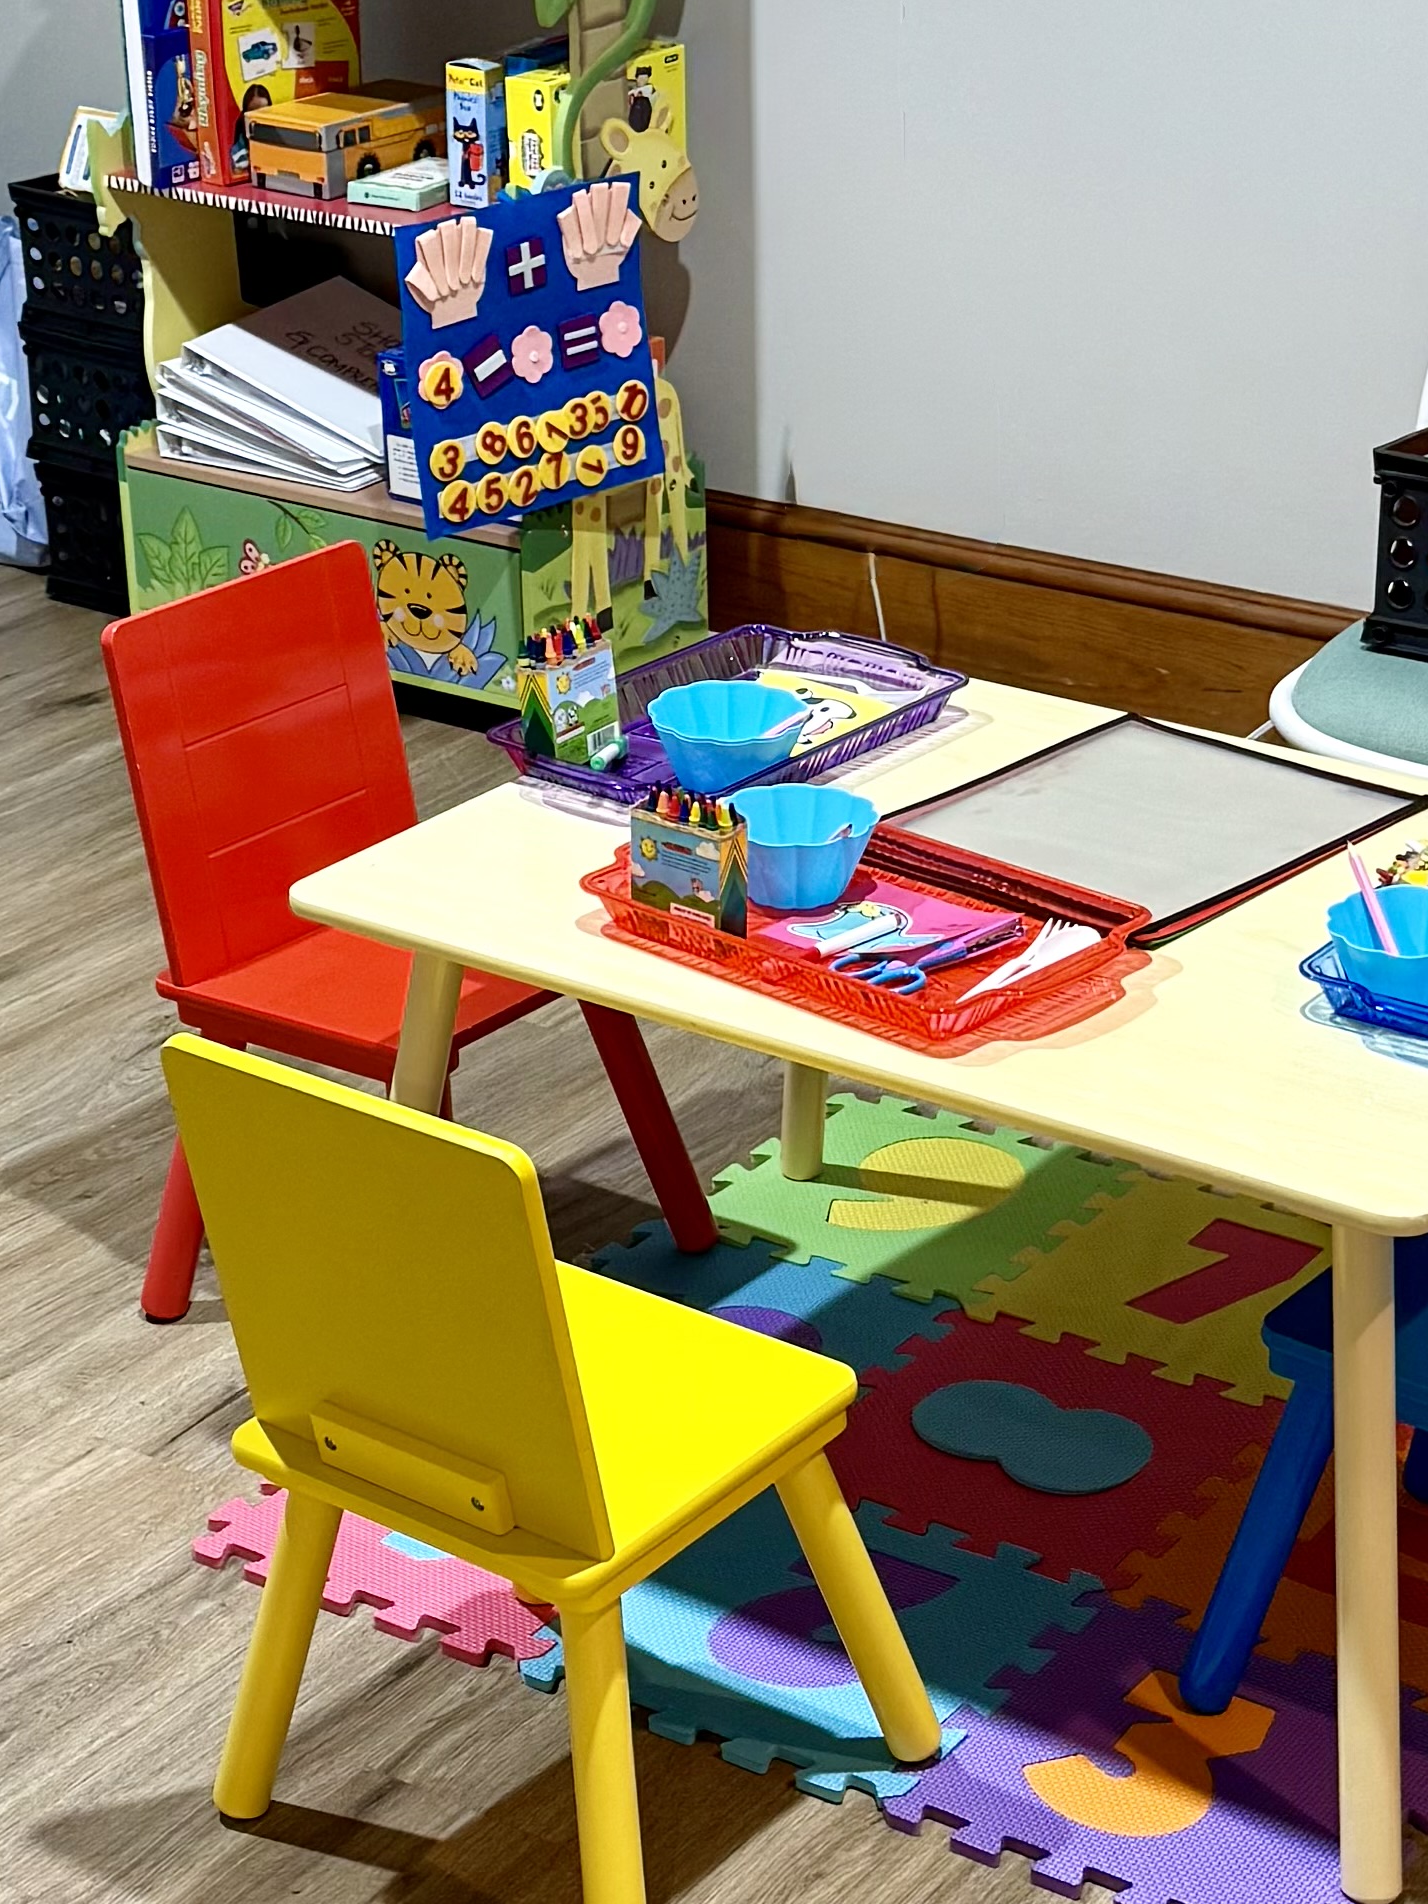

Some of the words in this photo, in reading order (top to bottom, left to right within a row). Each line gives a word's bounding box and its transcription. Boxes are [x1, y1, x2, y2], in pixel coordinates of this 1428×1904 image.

[439, 444, 459, 478] 3
[515, 421, 531, 454] 6
[569, 403, 589, 437] 3
[624, 383, 647, 421] 10
[448, 487, 469, 522] 4
[485, 477, 503, 511] 5
[515, 468, 538, 504] 2
